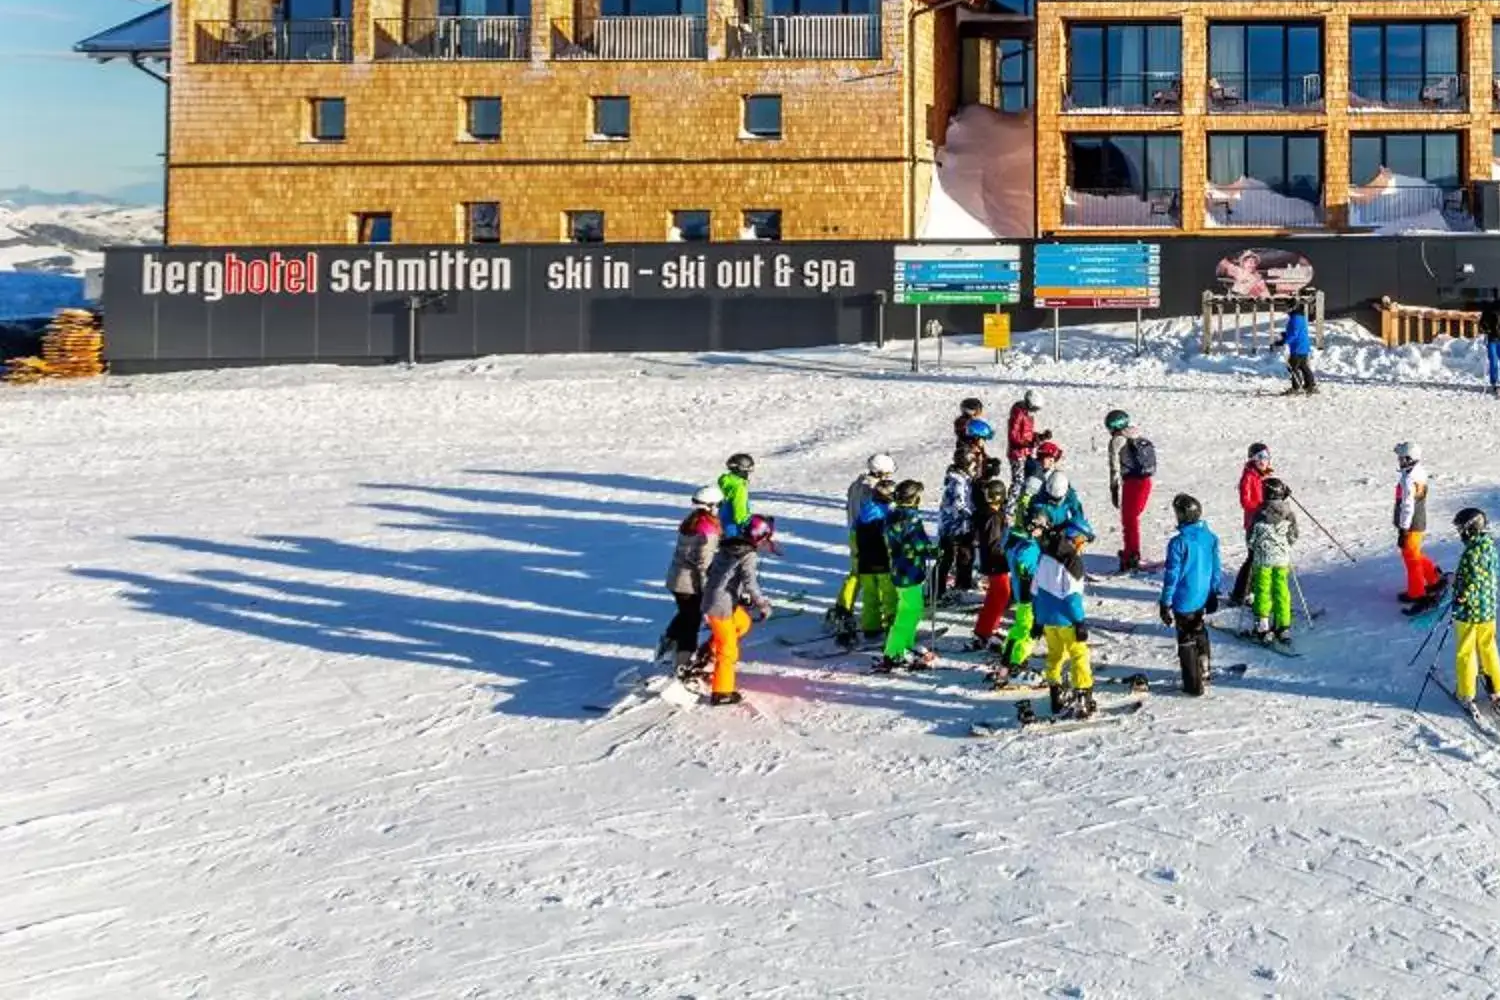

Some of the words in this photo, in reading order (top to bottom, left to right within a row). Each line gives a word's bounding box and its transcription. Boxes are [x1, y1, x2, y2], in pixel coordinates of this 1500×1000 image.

[143, 251, 318, 300] berghotel
[331, 251, 511, 292] schmitten
[548, 255, 593, 290] ski
[603, 255, 630, 290] in
[661, 254, 706, 290] ski
[716, 254, 765, 288] out
[774, 253, 796, 288] &
[803, 258, 856, 293] spa
